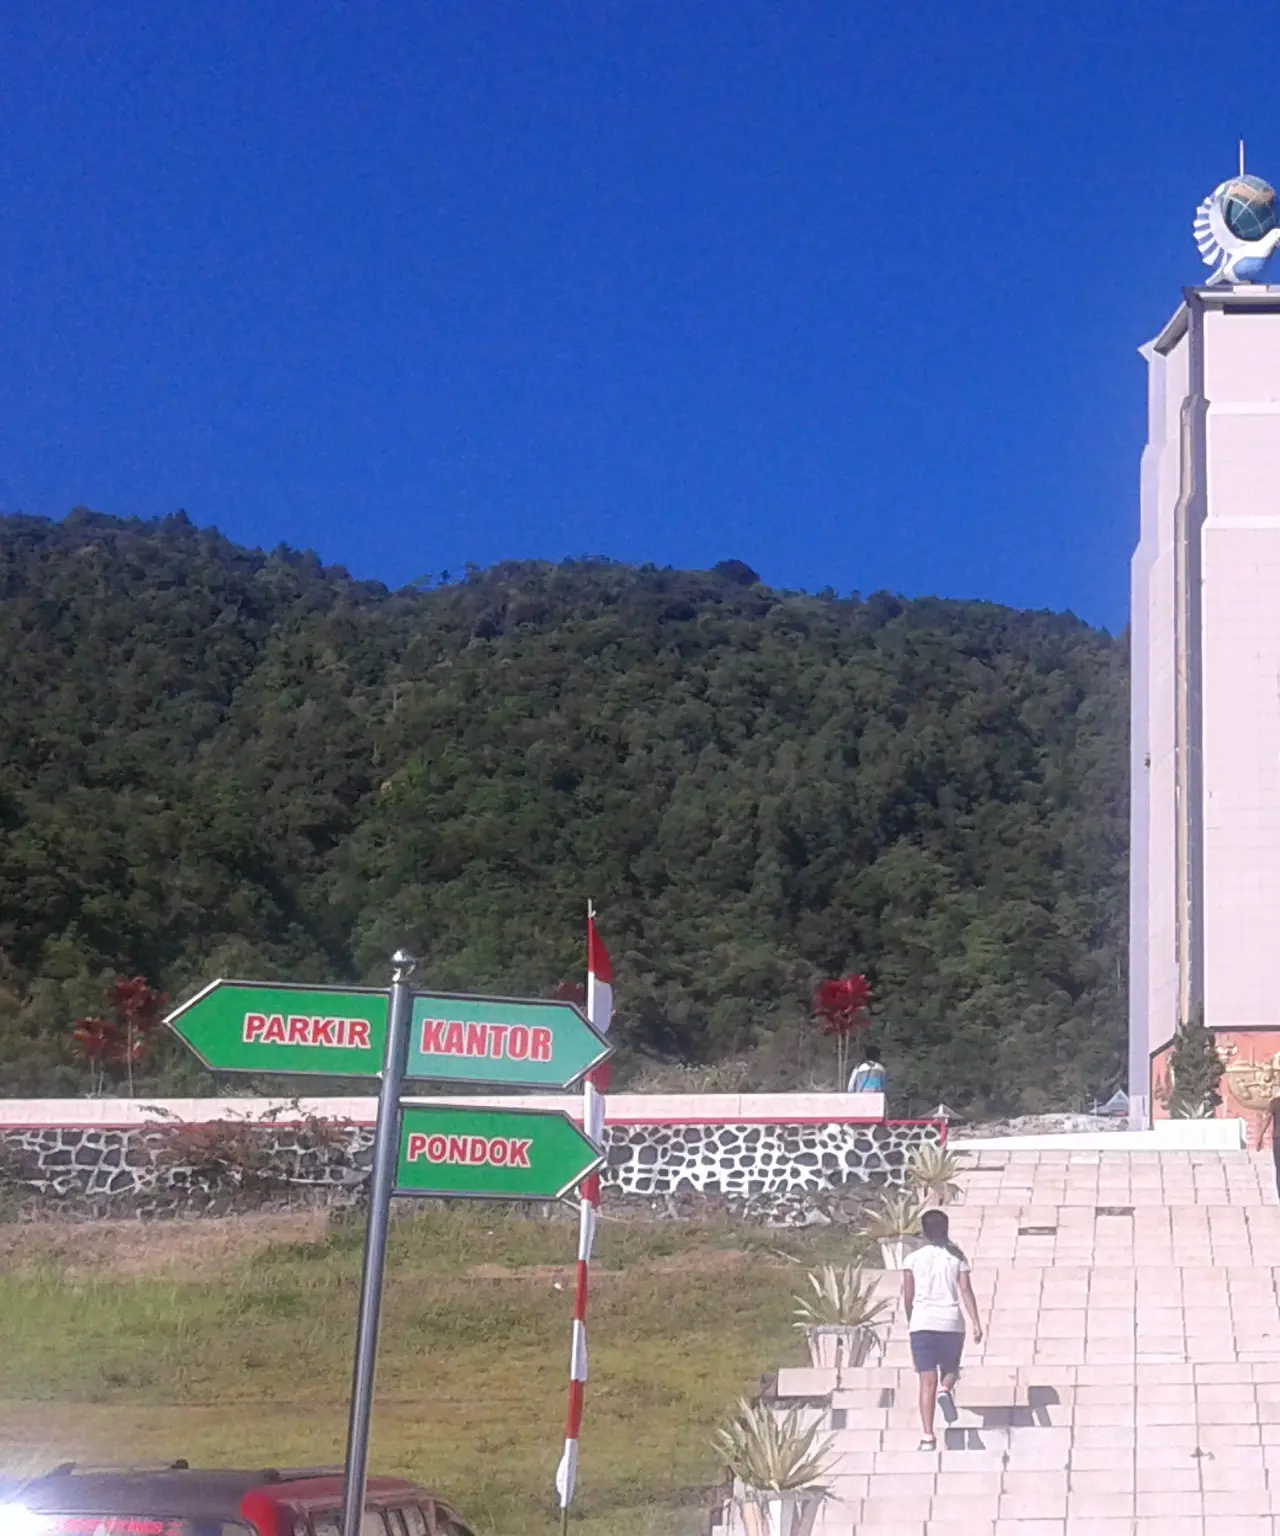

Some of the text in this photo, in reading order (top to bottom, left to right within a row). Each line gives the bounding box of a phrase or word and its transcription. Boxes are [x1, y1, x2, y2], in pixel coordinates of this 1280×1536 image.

[243, 1013, 372, 1048] PARKIR
[421, 1019, 553, 1062] KANTOR
[407, 1133, 532, 1168] PONDOK
